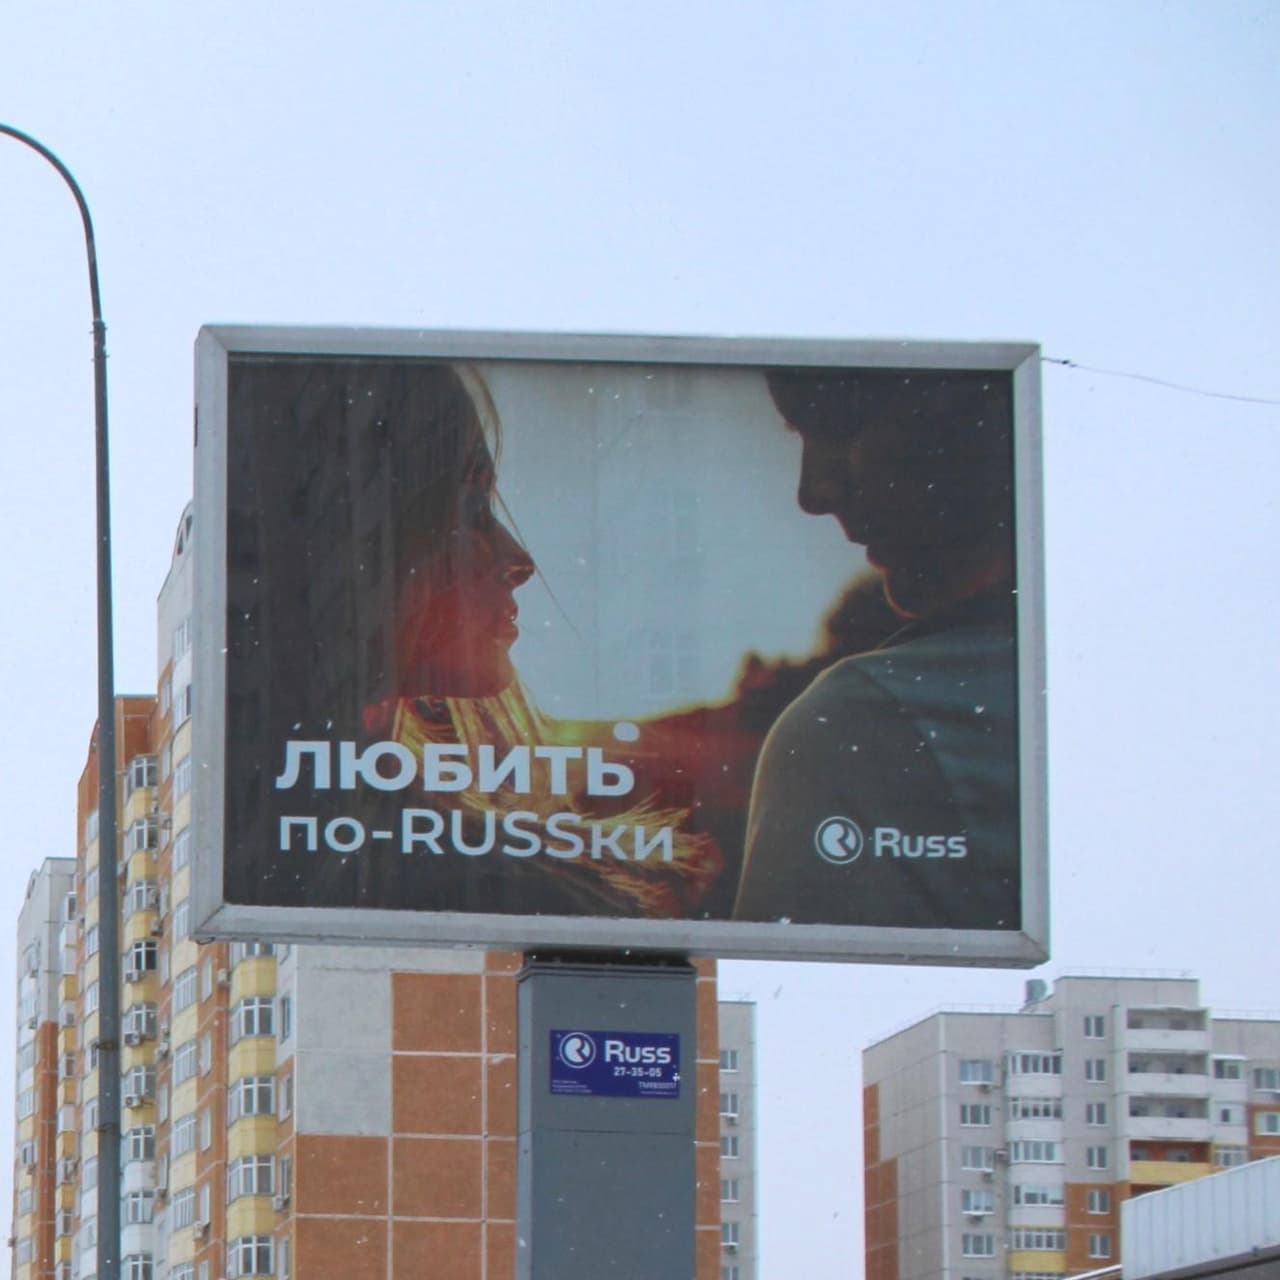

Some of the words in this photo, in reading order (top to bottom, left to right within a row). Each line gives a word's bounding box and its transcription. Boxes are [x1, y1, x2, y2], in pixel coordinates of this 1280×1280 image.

[275, 740, 635, 797] ЛЮБИТЬ
[279, 807, 674, 863] по-RUSSки
[874, 826, 968, 859] Russ
[604, 1039, 672, 1064] Russ
